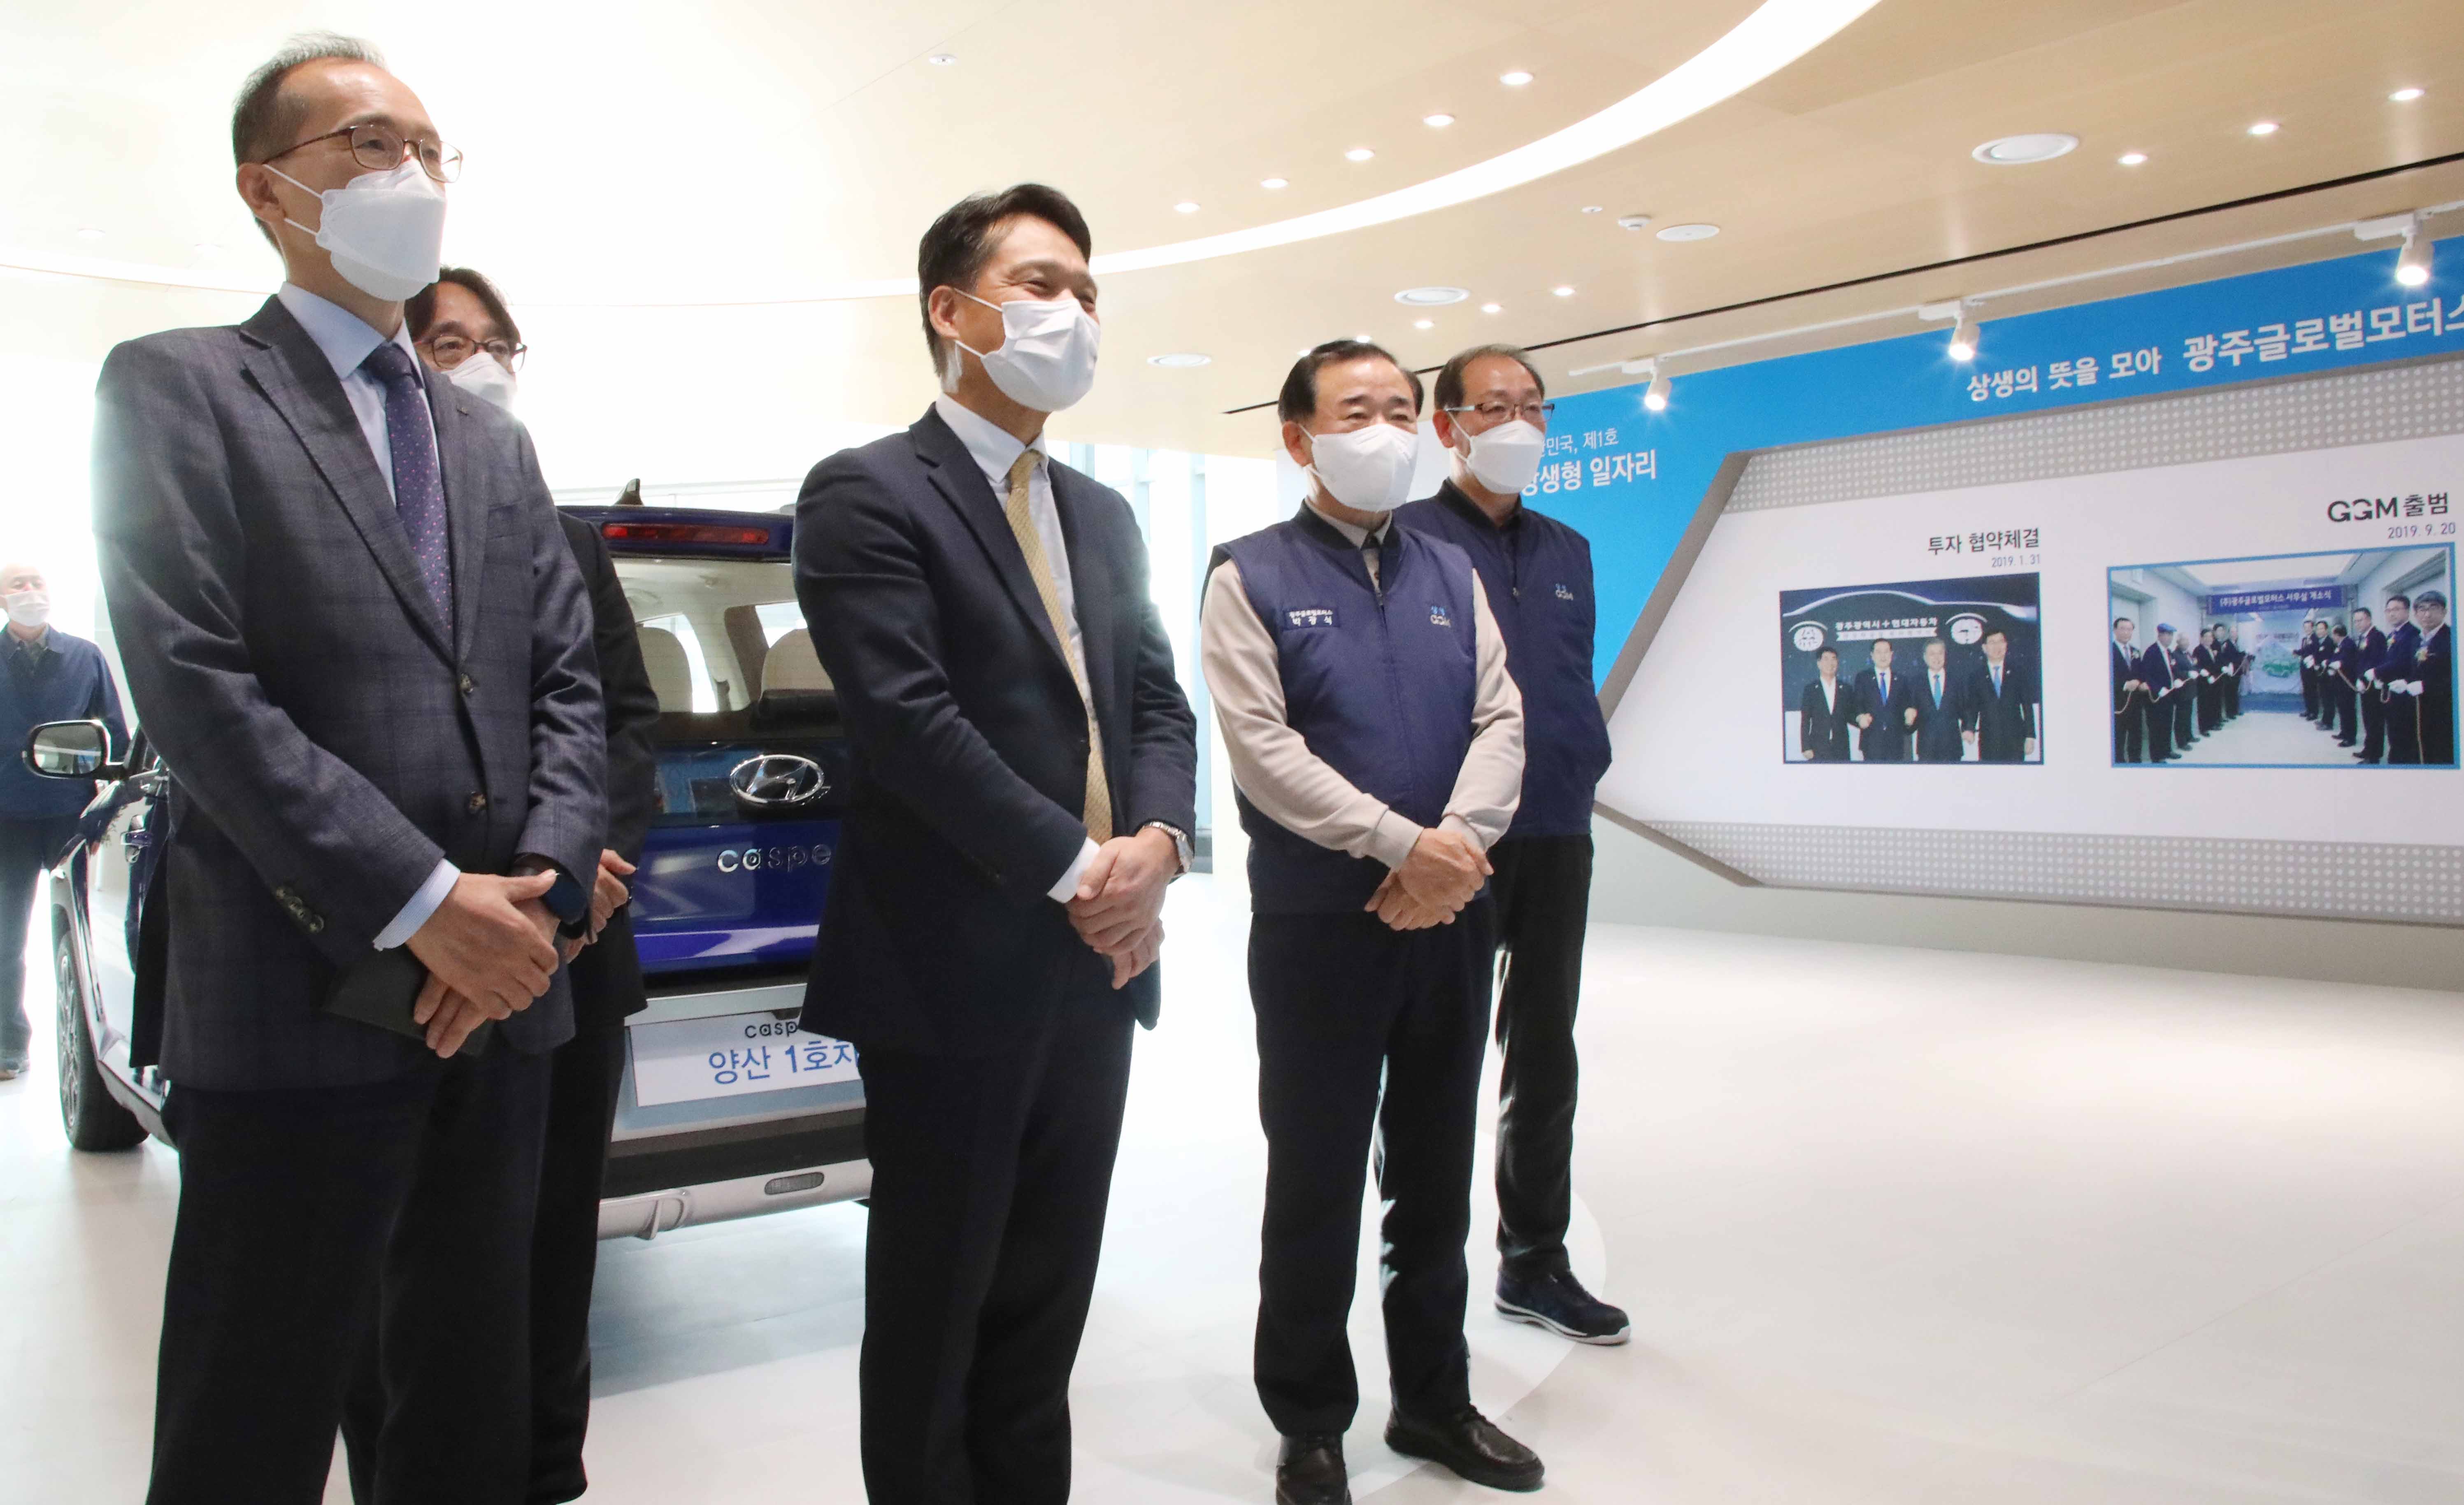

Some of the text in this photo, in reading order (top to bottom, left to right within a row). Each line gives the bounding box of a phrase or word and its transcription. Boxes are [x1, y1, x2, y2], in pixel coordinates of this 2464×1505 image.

[1967, 365, 2038, 402] 상생의
[2048, 356, 2099, 390] 뜻을
[2109, 346, 2163, 379] 모아
[1583, 428, 1619, 449] 제1호
[1590, 449, 1656, 487] 일자리
[2403, 492, 2448, 517] 출범
[1928, 527, 2039, 556] 투자 협약체결
[708, 1046, 771, 1084] 양산
